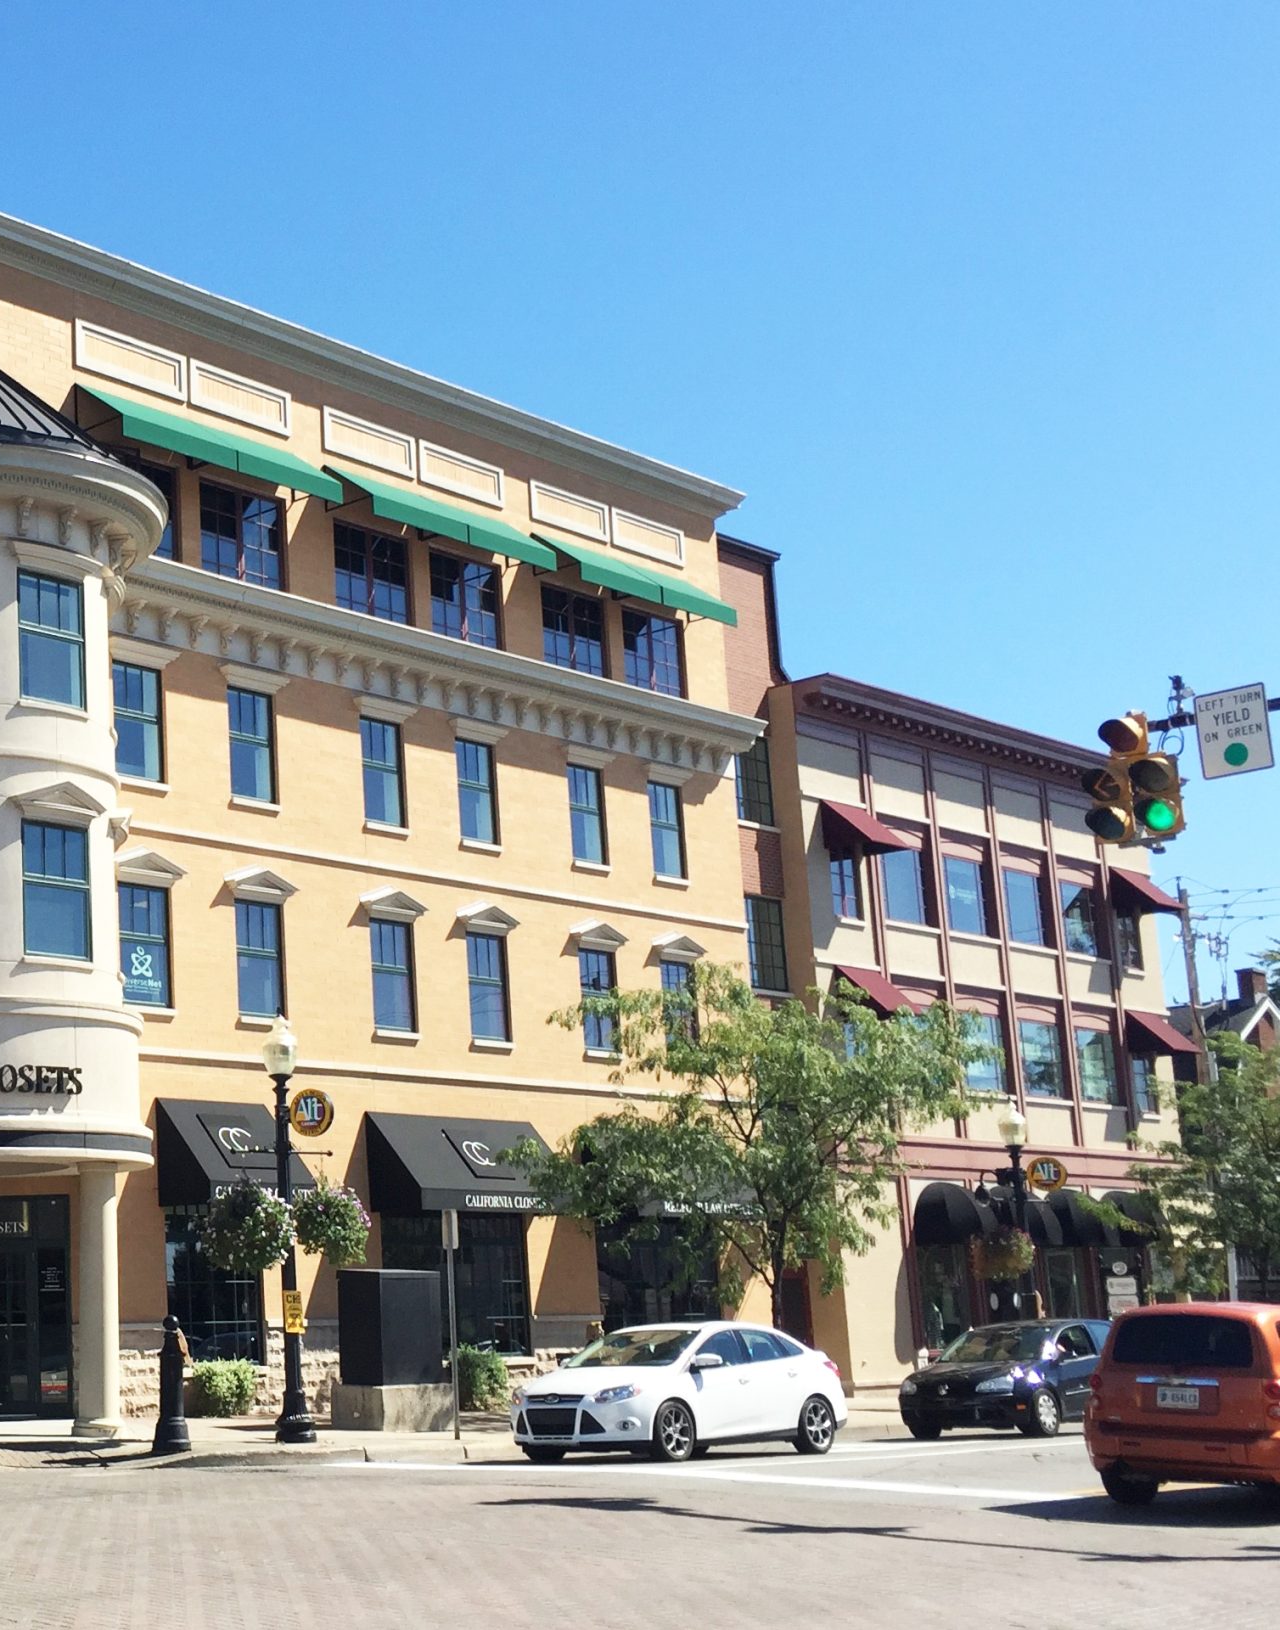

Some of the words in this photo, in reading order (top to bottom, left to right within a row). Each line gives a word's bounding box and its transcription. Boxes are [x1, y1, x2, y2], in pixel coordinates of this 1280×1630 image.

[1198, 698, 1224, 713] LEFT
[1233, 691, 1261, 705] TURN
[1213, 708, 1250, 726] YIELD
[1204, 732, 1219, 743] ON
[1227, 723, 1263, 739] GREEN
[465, 1194, 513, 1208] CALIFORNIA
